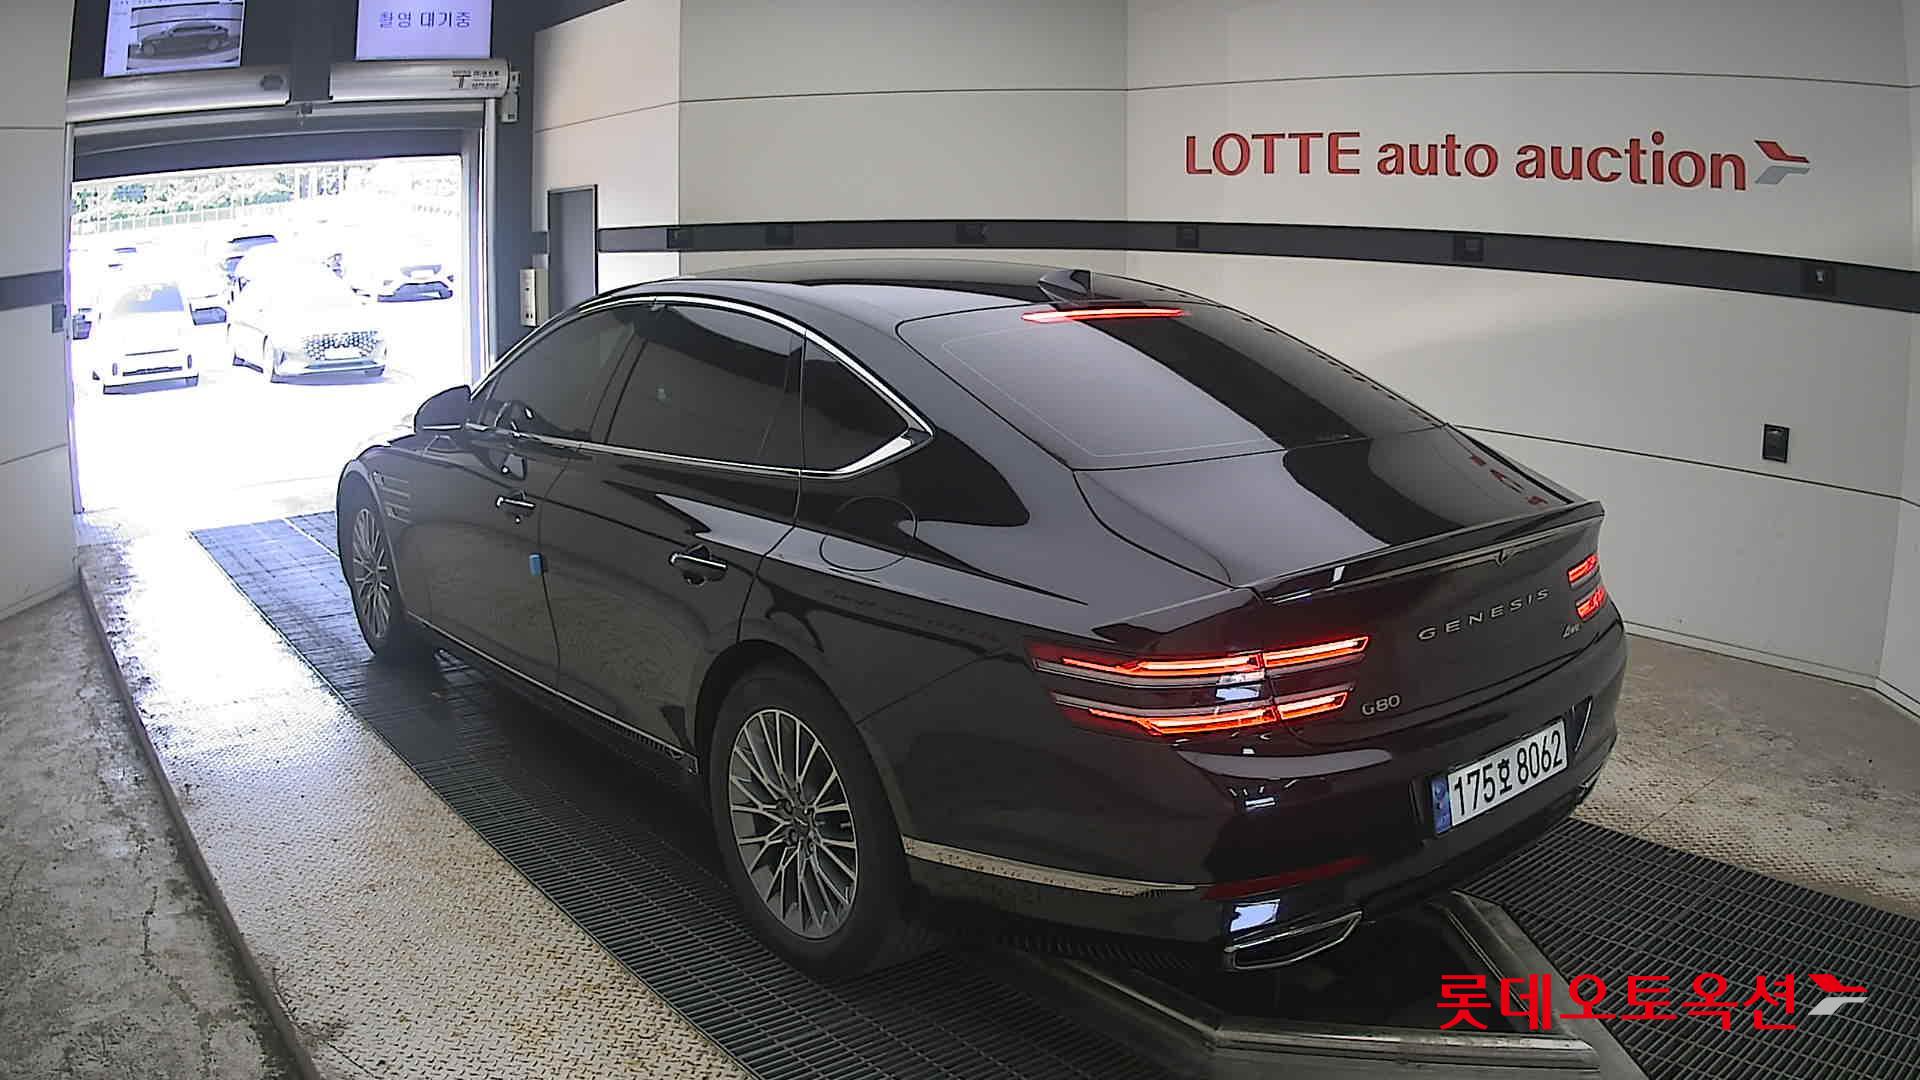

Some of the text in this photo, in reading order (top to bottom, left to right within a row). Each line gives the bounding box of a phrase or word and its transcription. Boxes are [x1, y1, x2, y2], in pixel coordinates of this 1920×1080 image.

[420, 11, 472, 28] 대기중
[1185, 131, 1747, 191] LOTTE auto auction
[1417, 588, 1550, 641] GENESIS
[1361, 695, 1401, 716] G80
[1516, 730, 1563, 785] 8062
